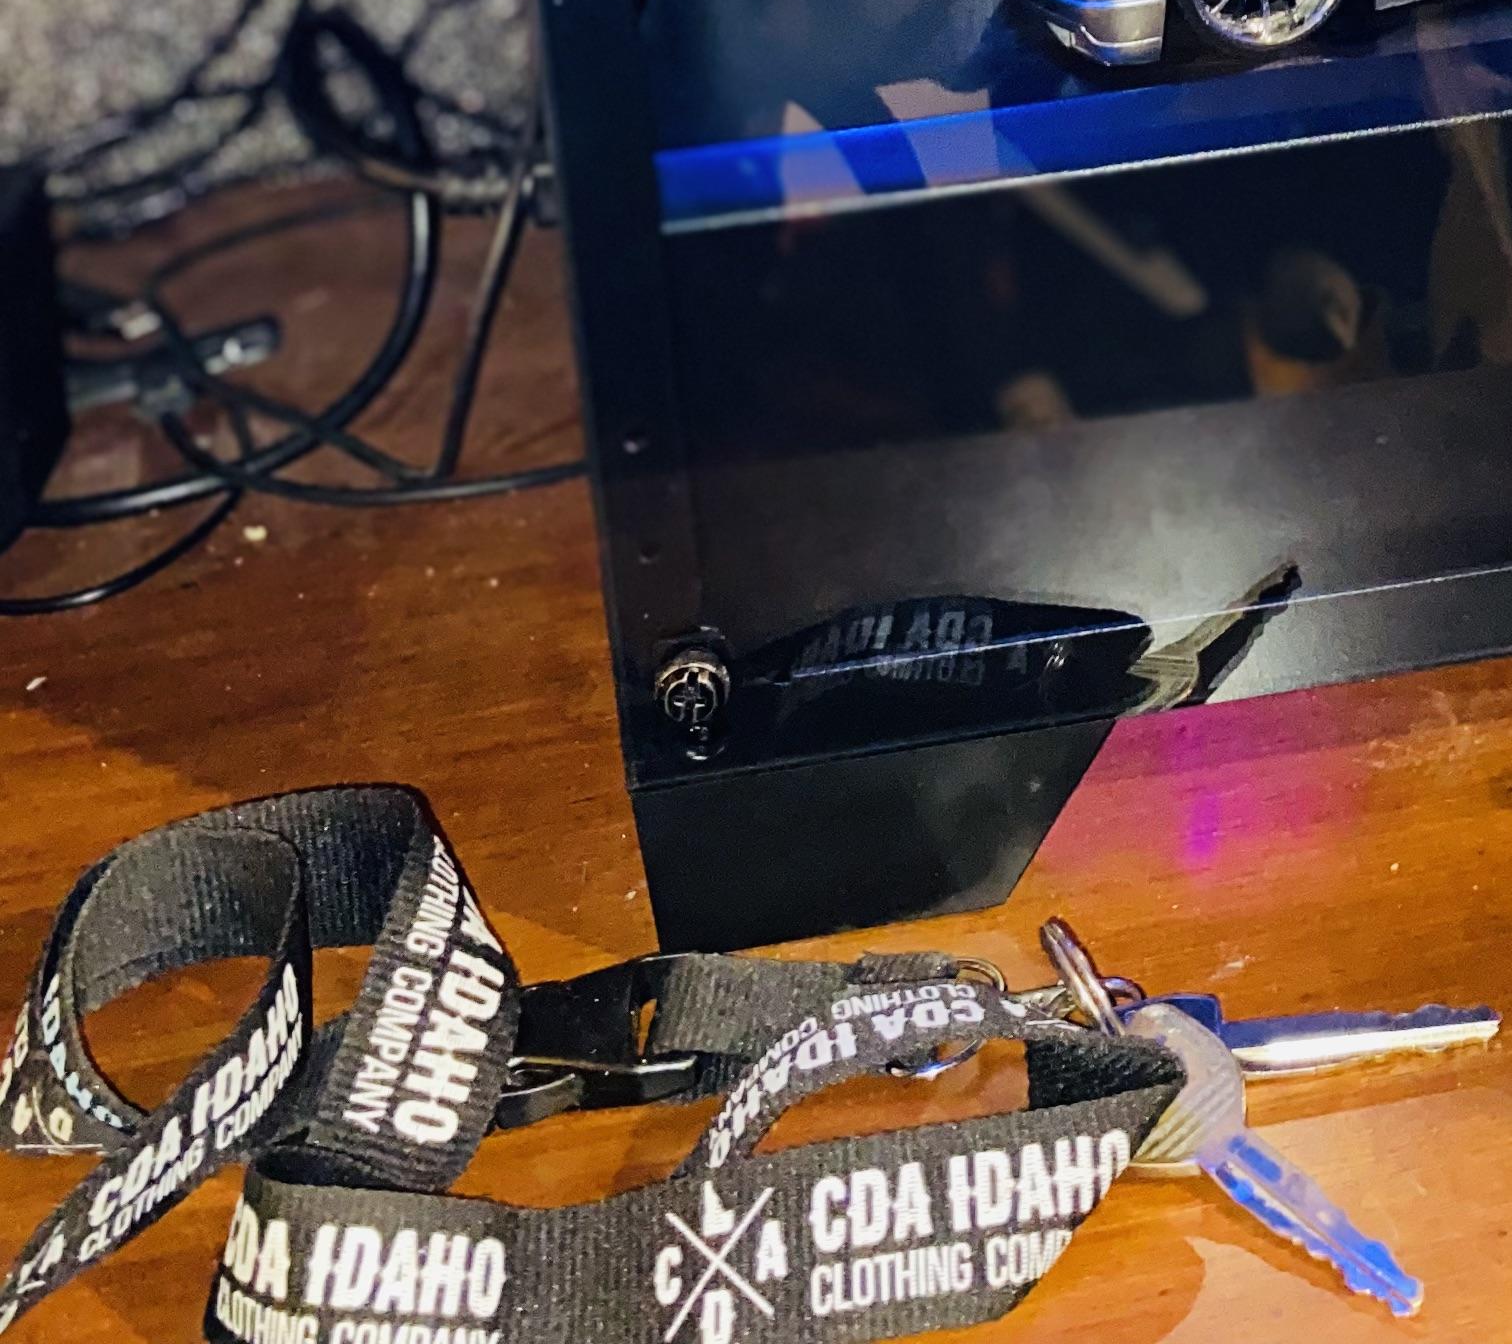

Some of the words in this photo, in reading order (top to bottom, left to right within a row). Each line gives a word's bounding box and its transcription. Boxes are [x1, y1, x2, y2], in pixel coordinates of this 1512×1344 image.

[342, 965, 433, 1134] COMPANY
[393, 949, 505, 1145] IDAHO
[831, 983, 979, 1020] CLOTHING
[871, 999, 986, 1041] CDA
[79, 1137, 206, 1262] CLOTHING
[215, 1012, 303, 1151] COMPAN
[88, 1115, 182, 1228] CDA
[190, 963, 300, 1137] IDAHO
[706, 1021, 859, 1170] IDAHO
[809, 1161, 934, 1254] CDA
[946, 1128, 1131, 1232] IDAHO
[303, 1224, 507, 1318] IDAHO
[810, 1240, 974, 1316] CLOTHING
[985, 1228, 1073, 1288] COMP
